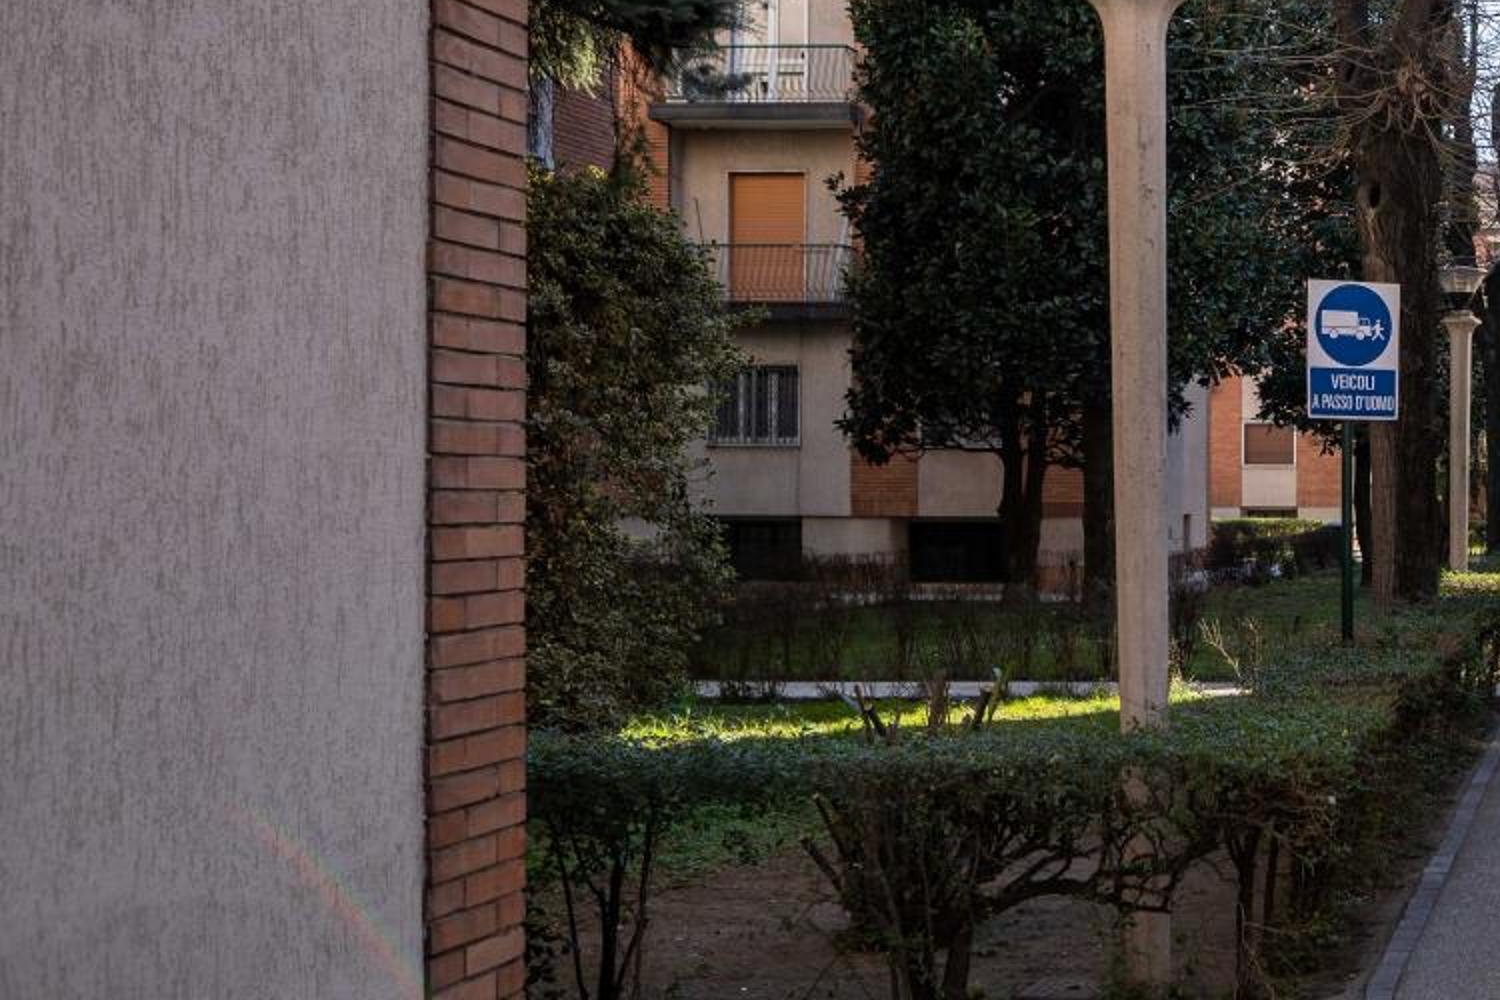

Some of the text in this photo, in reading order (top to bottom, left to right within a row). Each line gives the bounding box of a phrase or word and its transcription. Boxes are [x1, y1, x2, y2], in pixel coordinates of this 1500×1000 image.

[1331, 373, 1375, 391] VEICOLI
[1311, 393, 1394, 411] A PASSO D'UOMO
